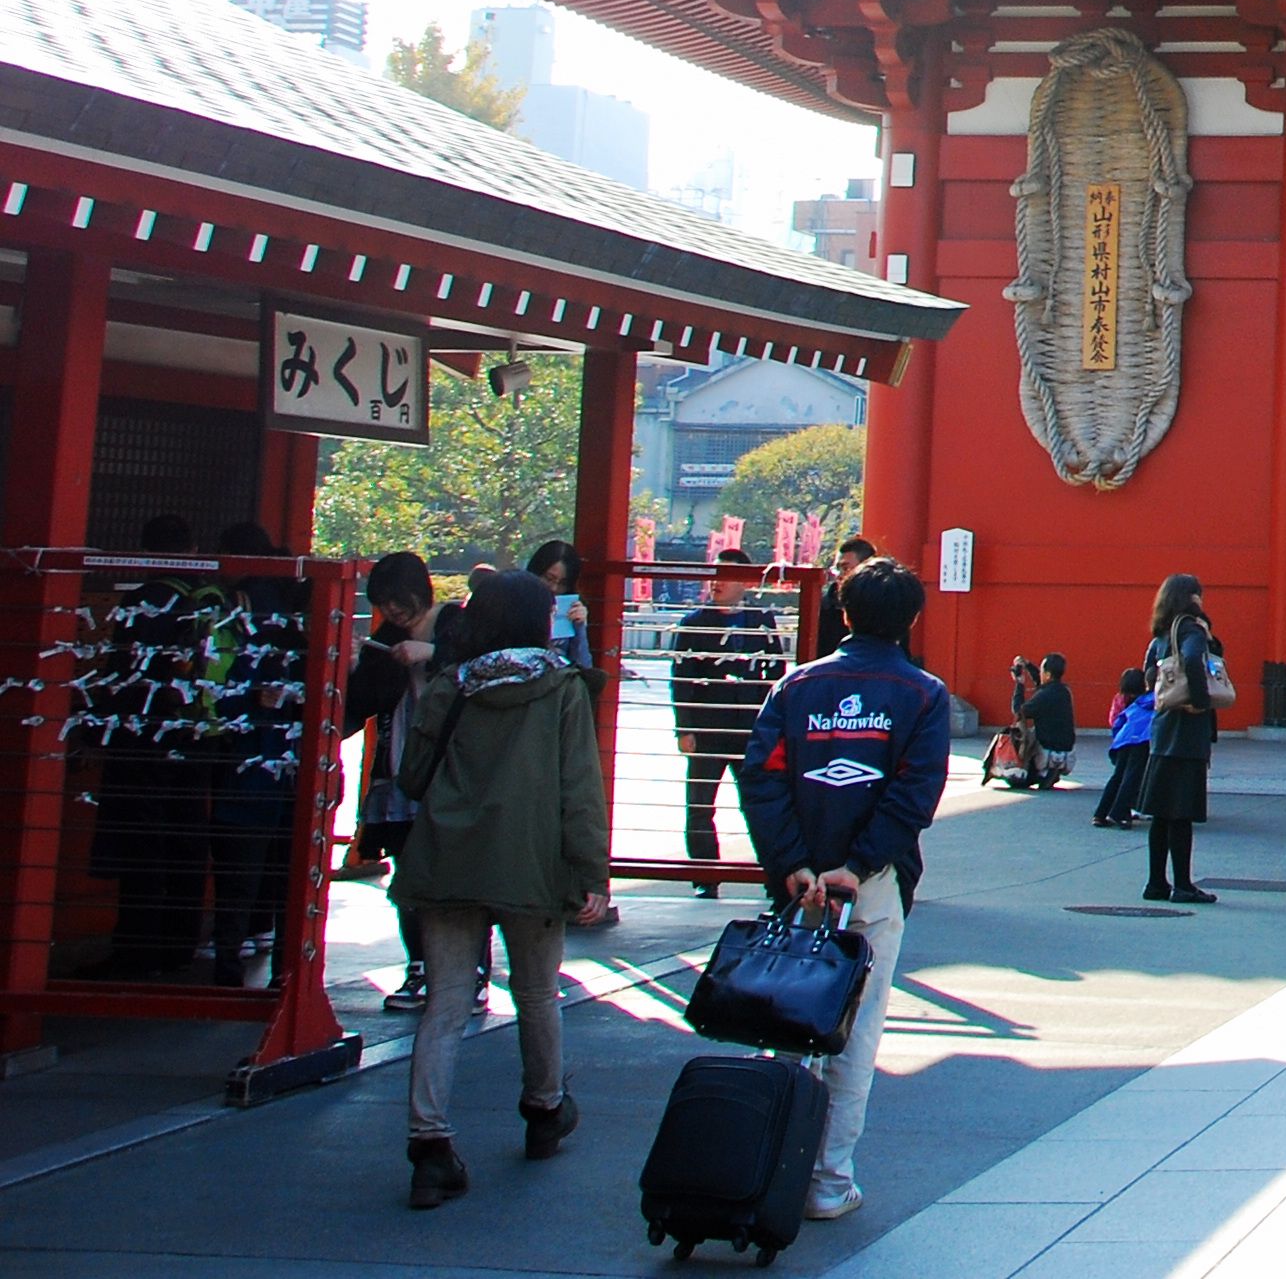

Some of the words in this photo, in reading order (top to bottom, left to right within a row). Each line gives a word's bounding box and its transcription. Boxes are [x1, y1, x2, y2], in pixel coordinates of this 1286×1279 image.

[281, 330, 409, 408] みくじ
[370, 400, 410, 424] 百円
[807, 712, 892, 731] Naionwide
